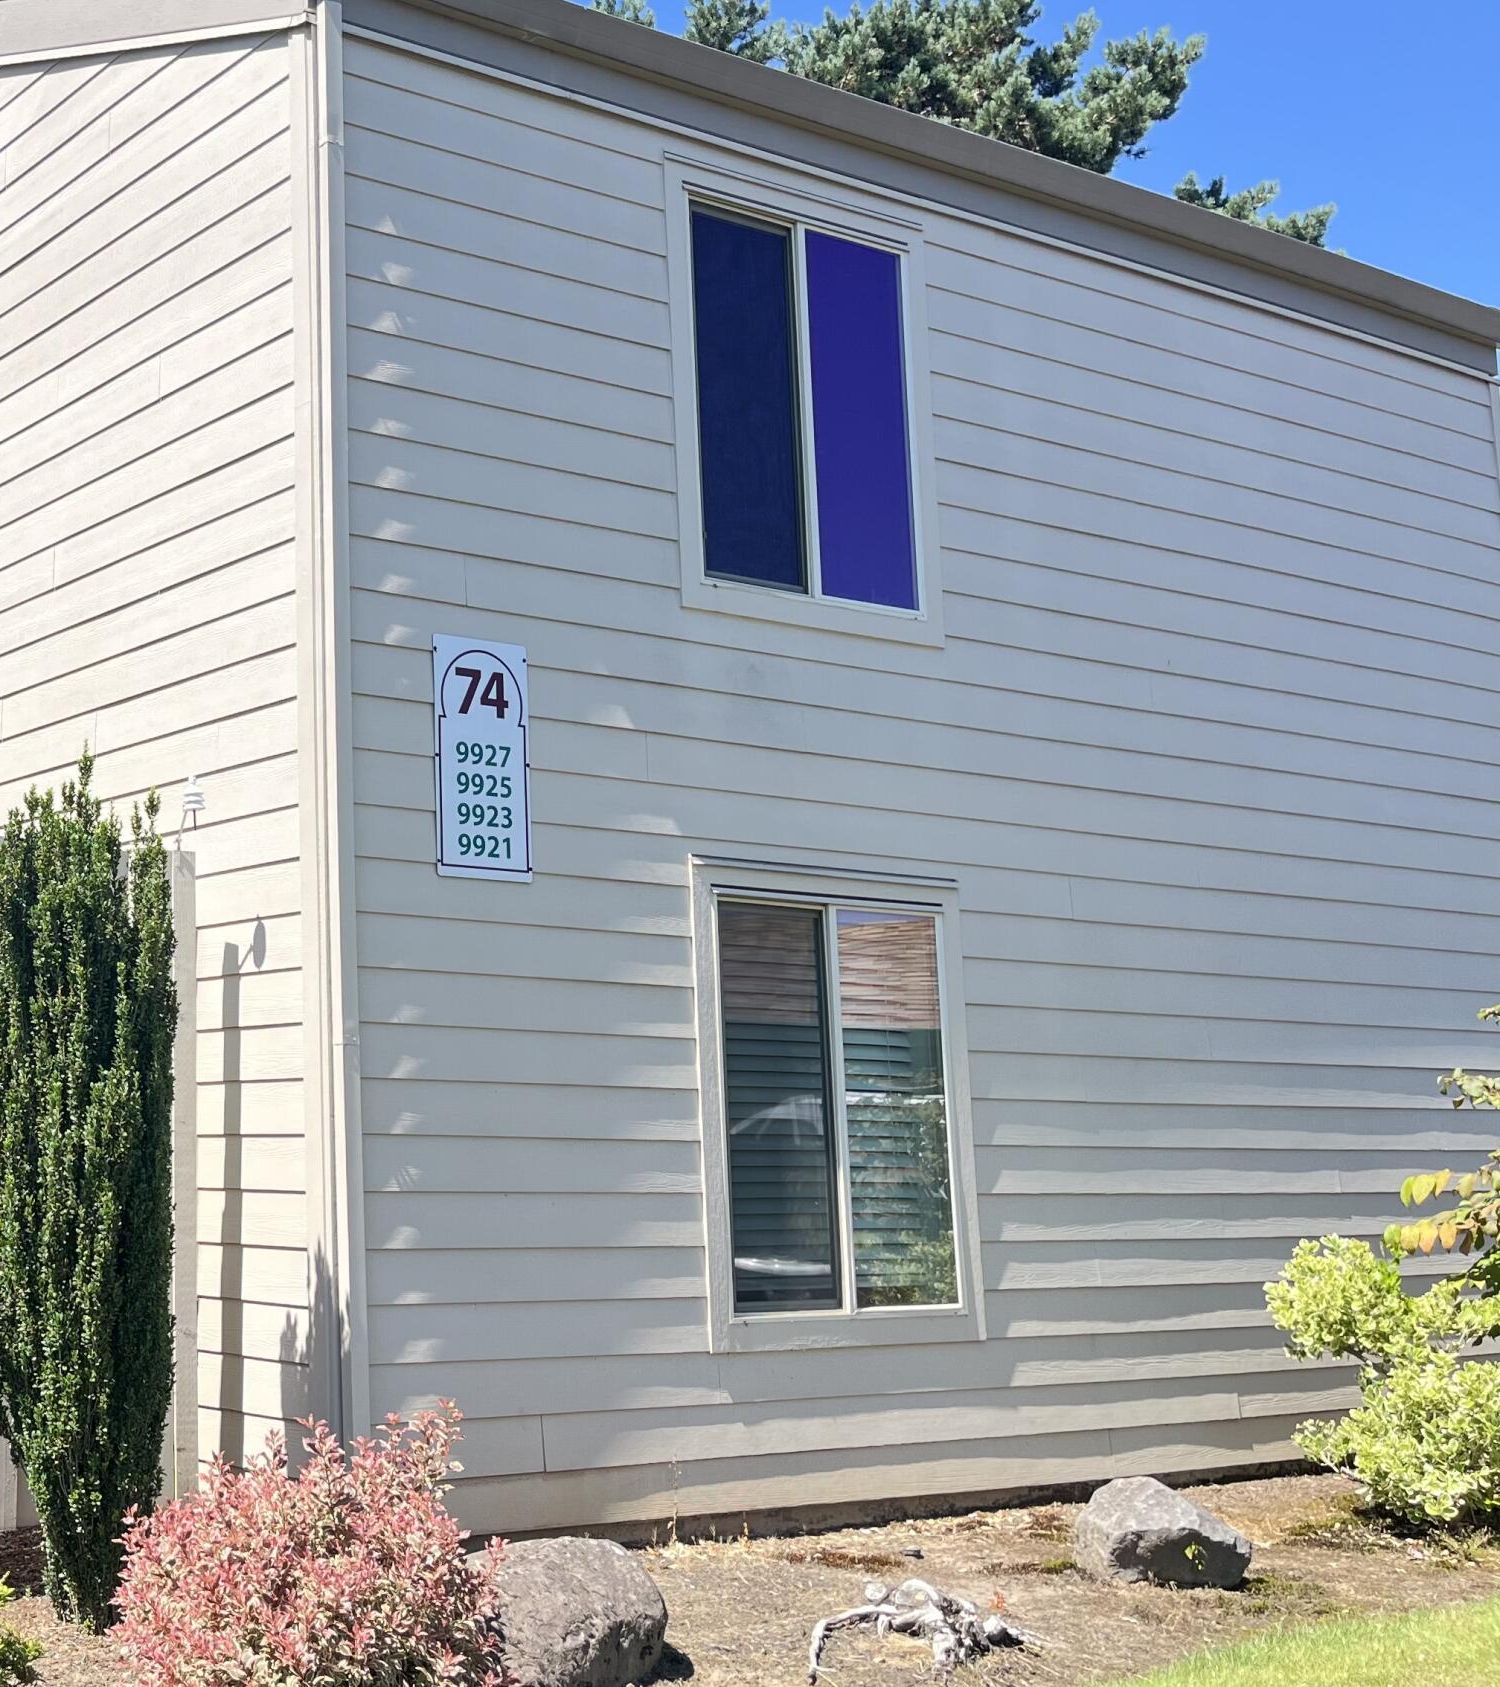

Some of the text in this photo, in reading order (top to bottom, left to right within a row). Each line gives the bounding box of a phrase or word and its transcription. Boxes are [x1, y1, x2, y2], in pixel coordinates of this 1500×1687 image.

[455, 666, 509, 719] 74
[455, 741, 512, 768] 9927
[456, 771, 512, 799] 9925
[457, 802, 513, 829] 9923
[458, 833, 512, 859] 9921
